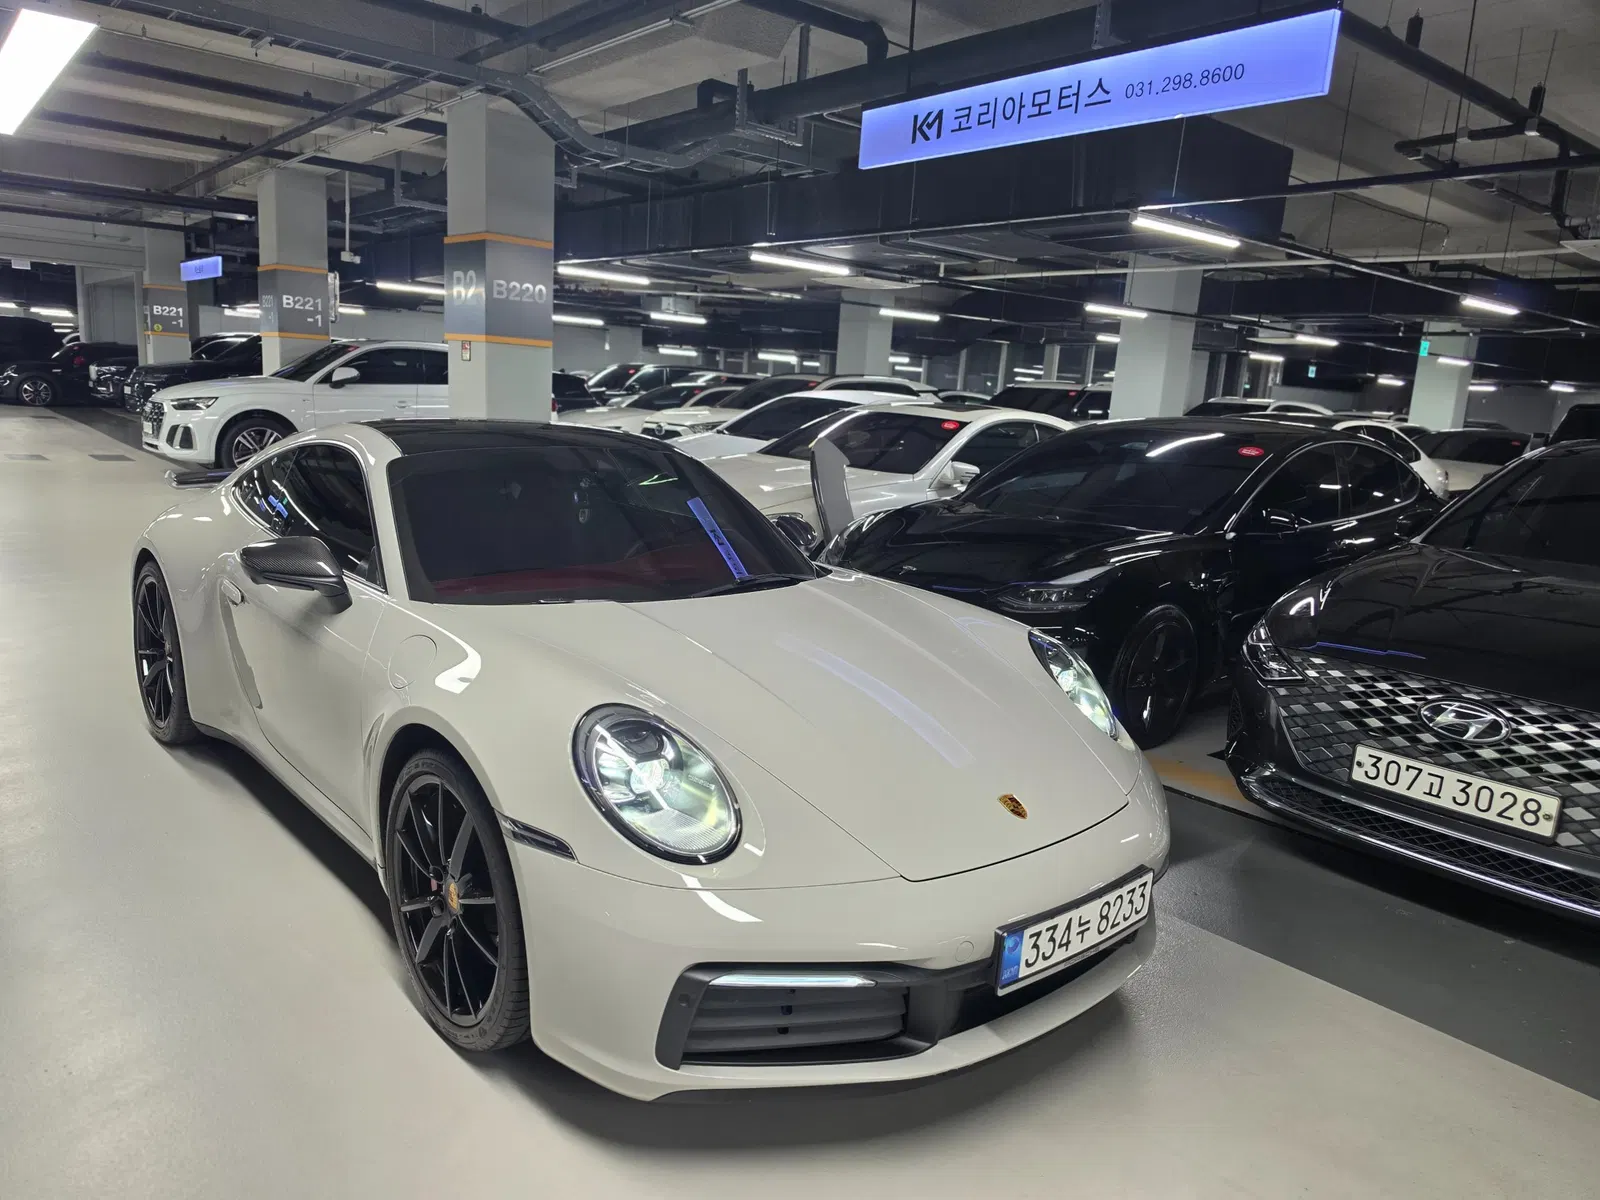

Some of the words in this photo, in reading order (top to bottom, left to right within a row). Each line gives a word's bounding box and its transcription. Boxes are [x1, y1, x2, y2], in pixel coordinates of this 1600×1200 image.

[950, 78, 1112, 134] 코리아모터스
[1125, 62, 1245, 99] 031.298.8600
[493, 279, 547, 304] B220
[153, 305, 183, 317] B221
[282, 294, 322, 312] B221
[171, 318, 184, 328] -1
[307, 314, 322, 328] -1
[1452, 779, 1543, 826] 3028
[1024, 914, 1091, 968] 334누
[1097, 881, 1148, 936] 8233
